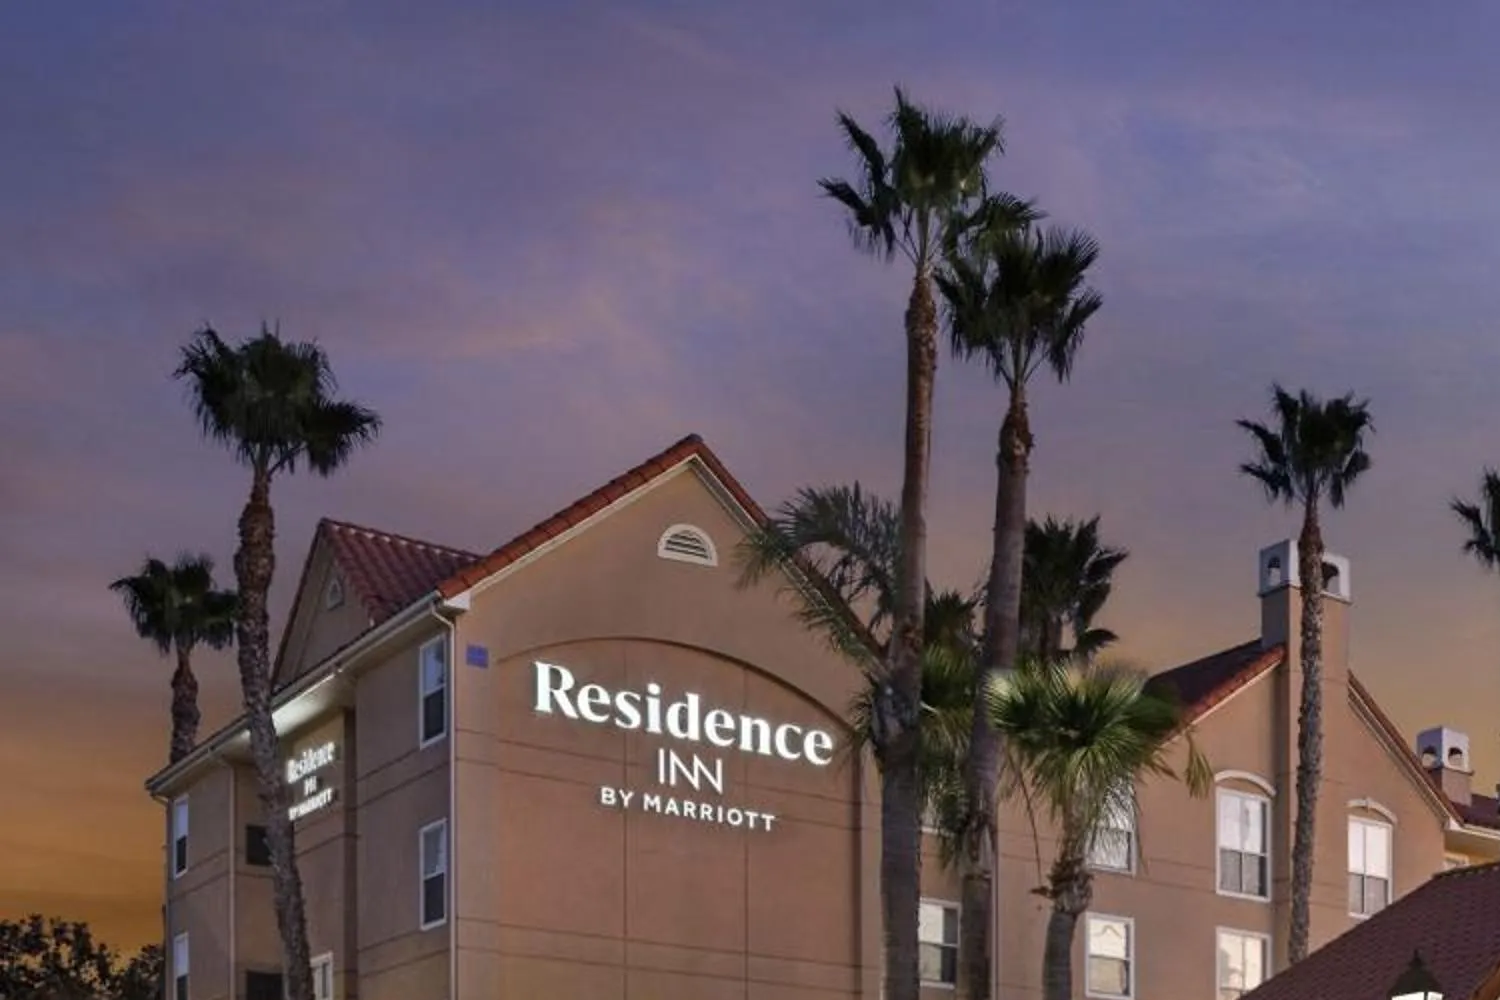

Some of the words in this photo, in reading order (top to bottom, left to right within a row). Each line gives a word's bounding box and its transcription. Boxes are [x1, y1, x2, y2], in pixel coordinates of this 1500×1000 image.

[533, 661, 833, 766] Residence
[659, 748, 723, 794] INN
[600, 787, 635, 809] BY
[643, 794, 777, 832] MARRIOTT
